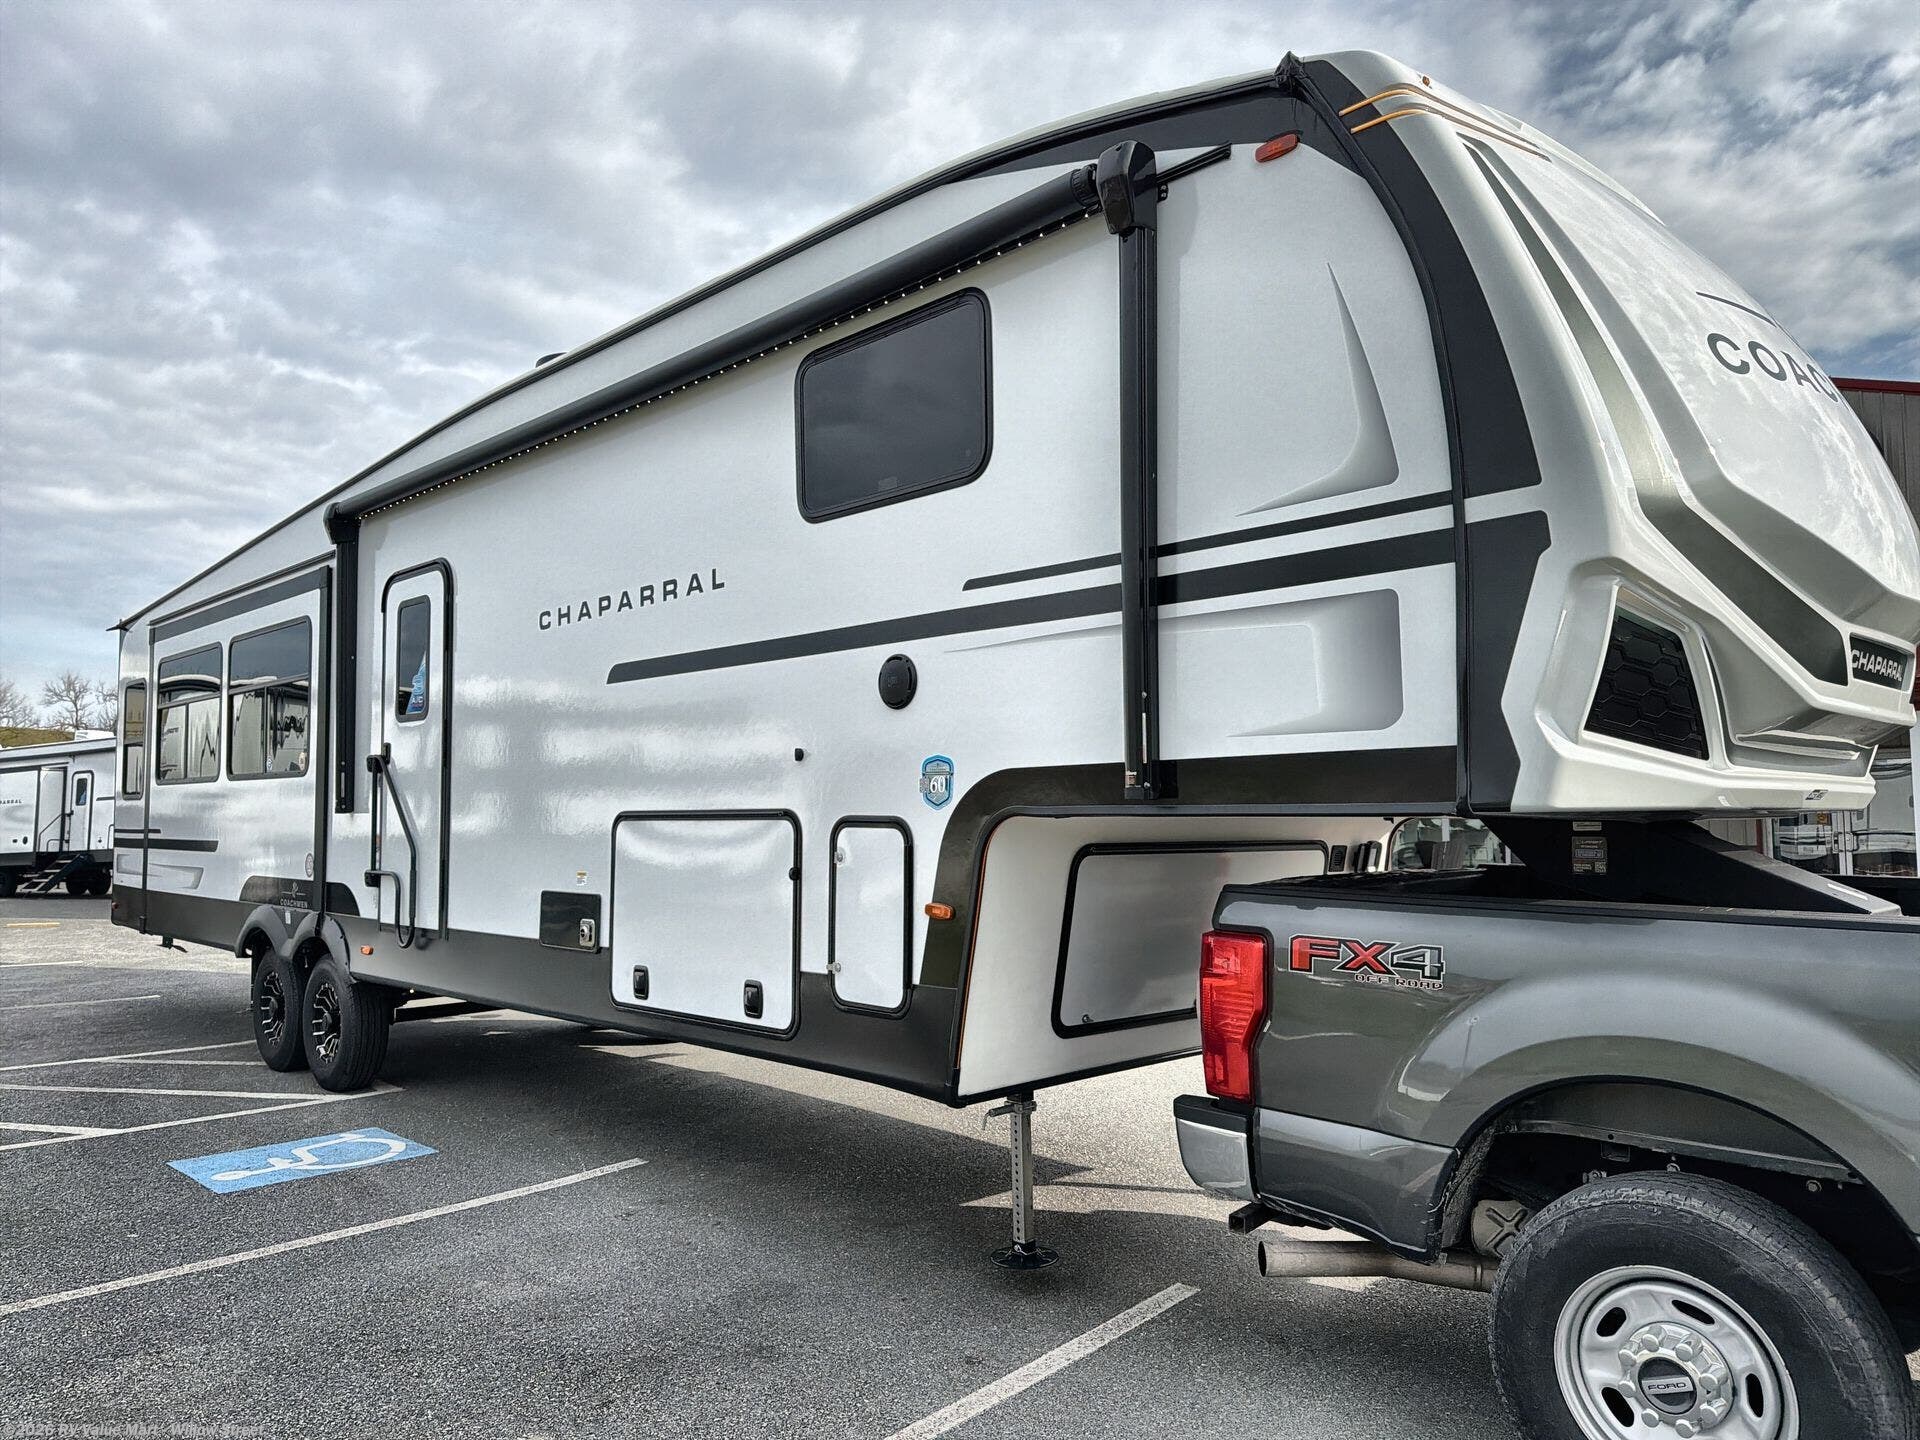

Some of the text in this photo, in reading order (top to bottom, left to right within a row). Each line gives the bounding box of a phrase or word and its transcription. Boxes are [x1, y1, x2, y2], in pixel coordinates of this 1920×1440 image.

[1707, 332, 1838, 402] COAC
[539, 568, 725, 630] CHAPARRAL
[1289, 934, 1445, 982] FX4
[1355, 973, 1444, 990] OFF ROAD
[1647, 1382, 1687, 1391] FORD
